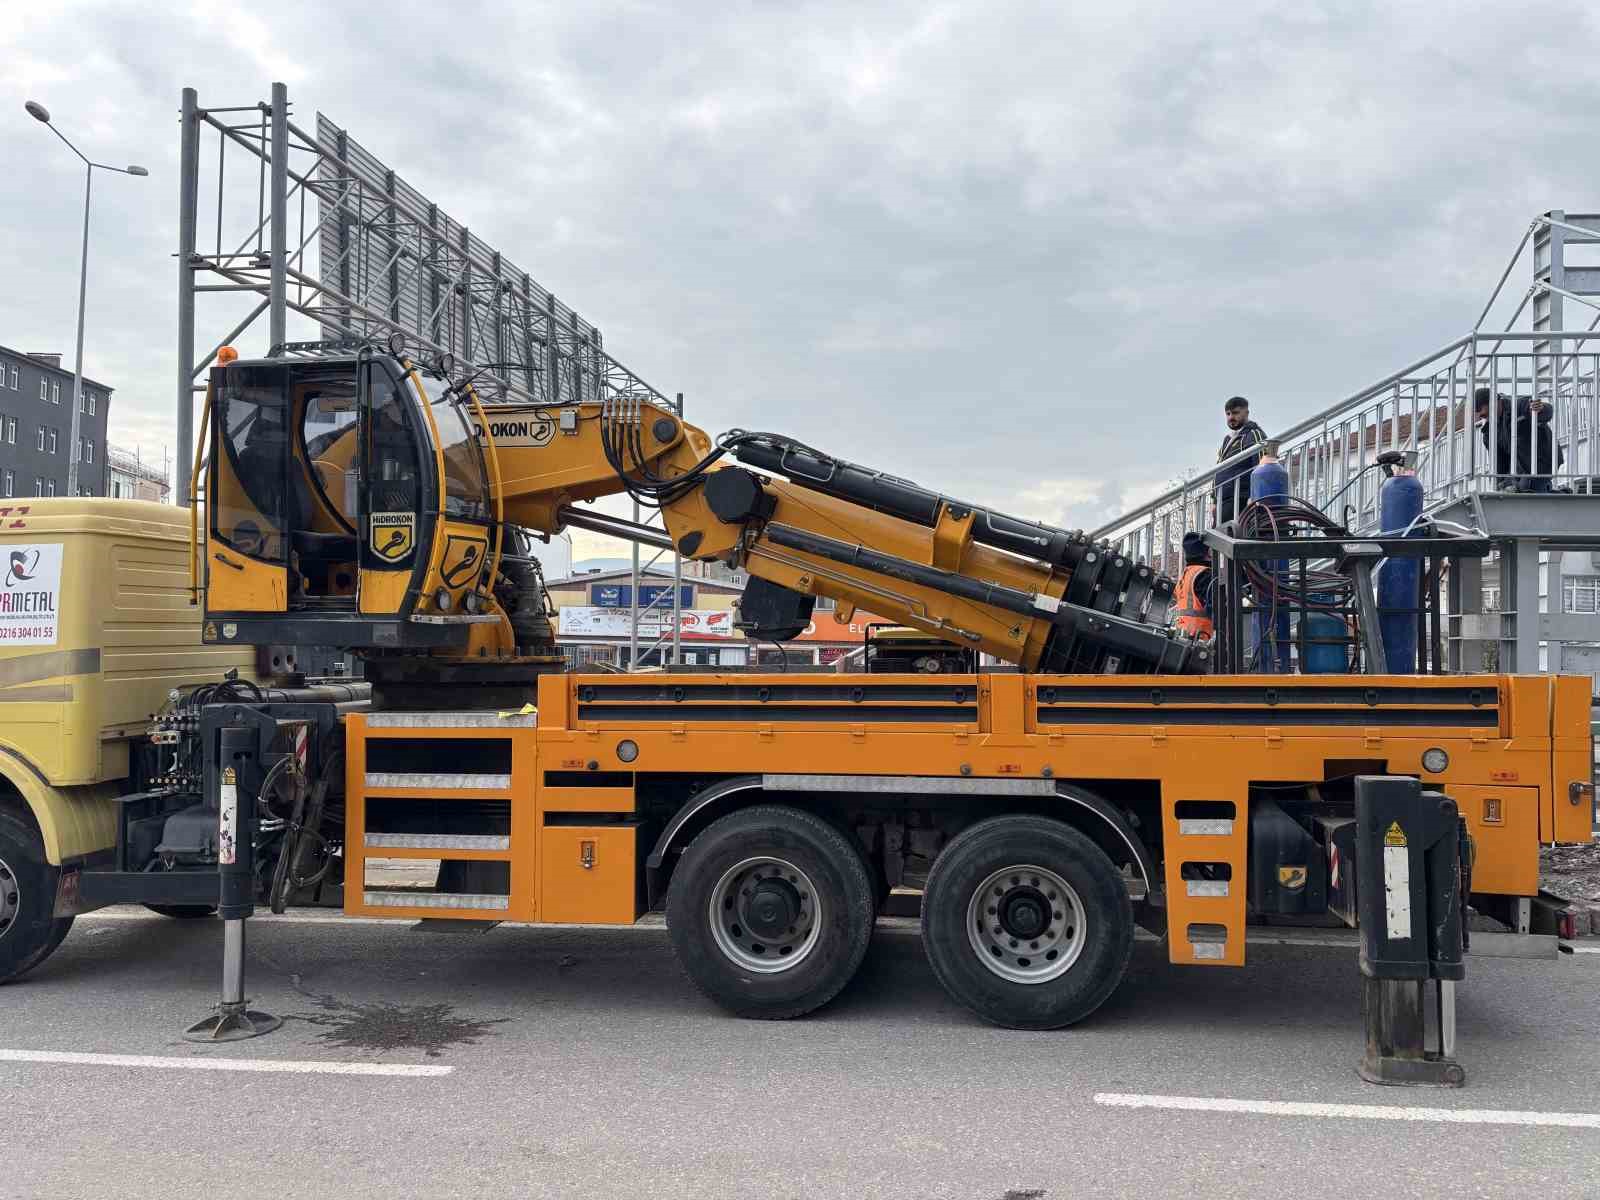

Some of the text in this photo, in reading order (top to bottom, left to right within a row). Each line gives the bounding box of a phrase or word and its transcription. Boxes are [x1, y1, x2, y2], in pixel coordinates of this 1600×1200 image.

[17, 627, 32, 638] 304
[33, 626, 42, 638] 01
[43, 626, 53, 638] 55
